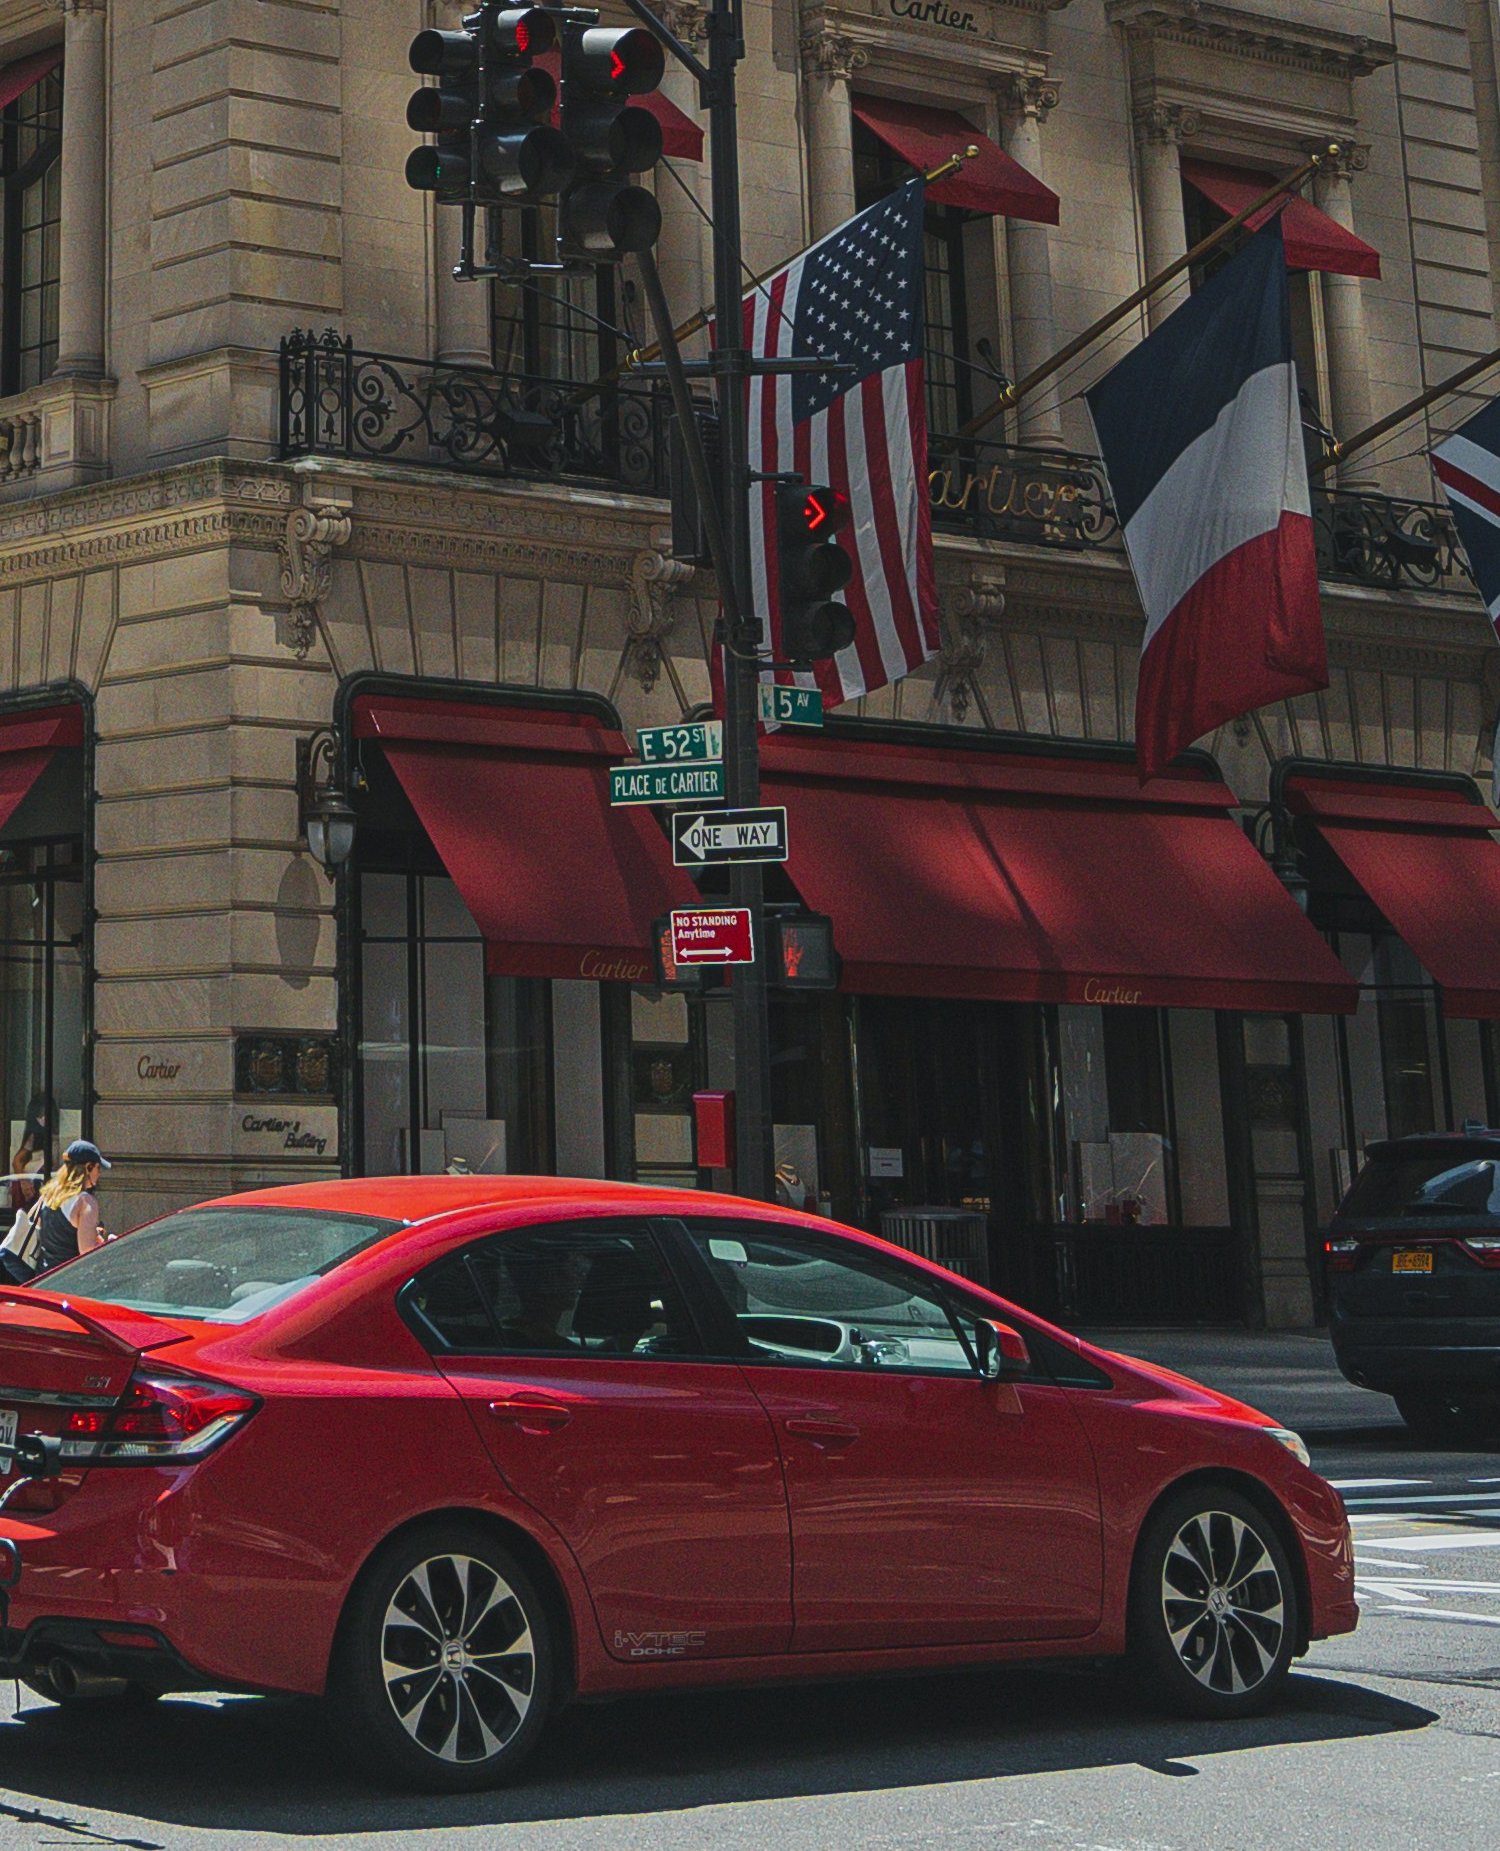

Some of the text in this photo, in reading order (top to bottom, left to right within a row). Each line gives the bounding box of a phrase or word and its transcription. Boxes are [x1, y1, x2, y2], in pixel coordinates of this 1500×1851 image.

[928, 465, 1076, 519] artier
[780, 691, 809, 718] 5 AV
[642, 728, 705, 761] E 52 ST
[615, 775, 650, 796] PLACE
[671, 771, 718, 794] CARTIER
[690, 825, 771, 848] ONE WAY
[676, 915, 737, 927] NO STANDING
[678, 928, 716, 939] Anytime
[580, 949, 649, 979] Cartier
[1084, 978, 1143, 1005] Cartier
[137, 1055, 181, 1079] Cartier
[630, 1647, 686, 1656] DOHC
